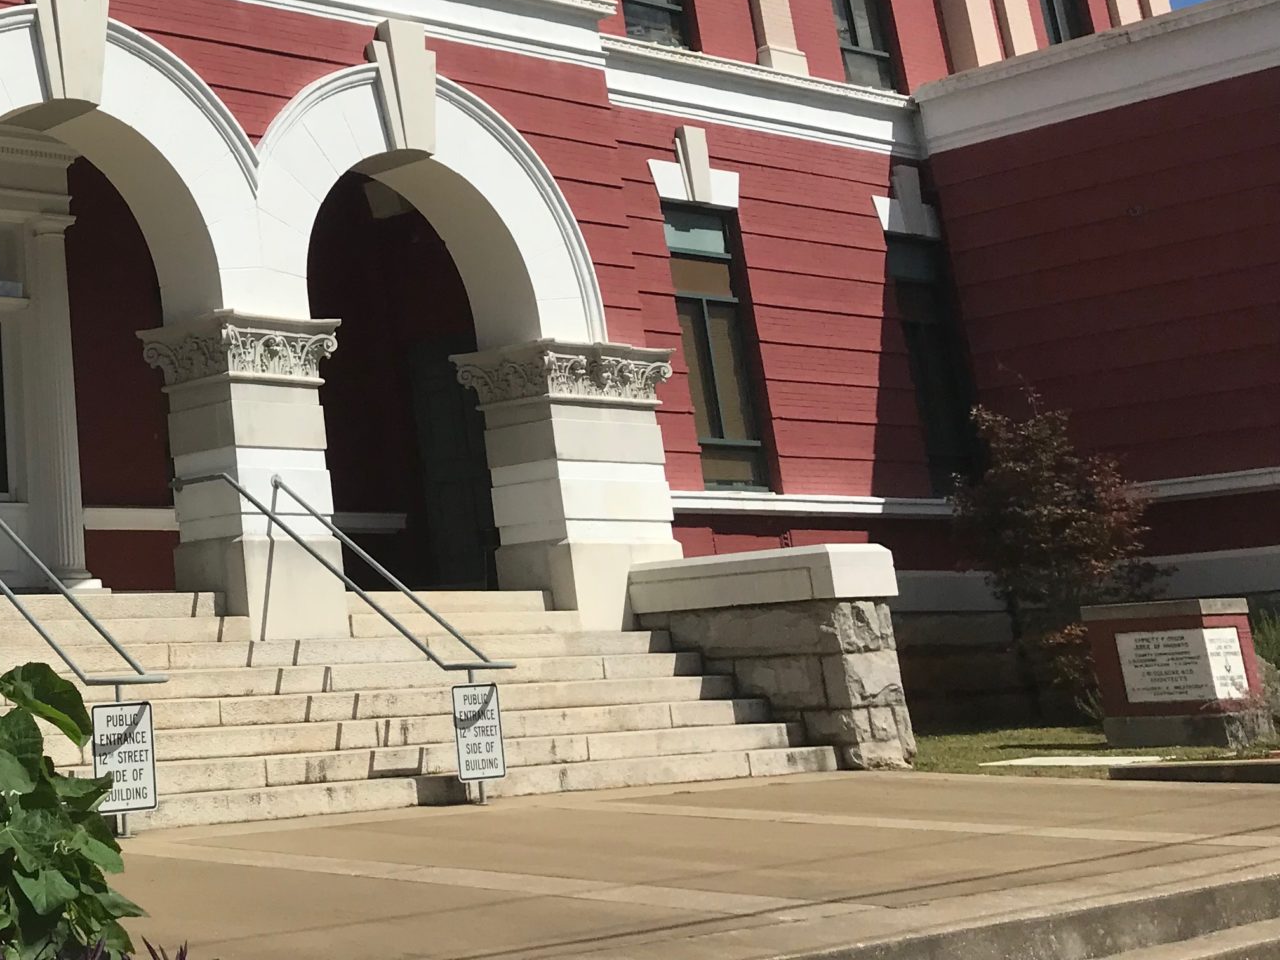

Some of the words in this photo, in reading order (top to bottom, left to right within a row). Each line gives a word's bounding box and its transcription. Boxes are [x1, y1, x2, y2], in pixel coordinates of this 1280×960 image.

[463, 693, 489, 706] PUBLIC
[106, 713, 138, 727] PUBLIC
[458, 708, 496, 722] ENTRANCE
[473, 725, 498, 737] STREET
[99, 731, 147, 746] ENTRANCE
[465, 743, 482, 755] SIDE
[485, 741, 495, 753] OF
[117, 749, 149, 764] STREET
[465, 758, 499, 771] BUILDING
[111, 769, 128, 783] IDE
[132, 768, 144, 781] OF
